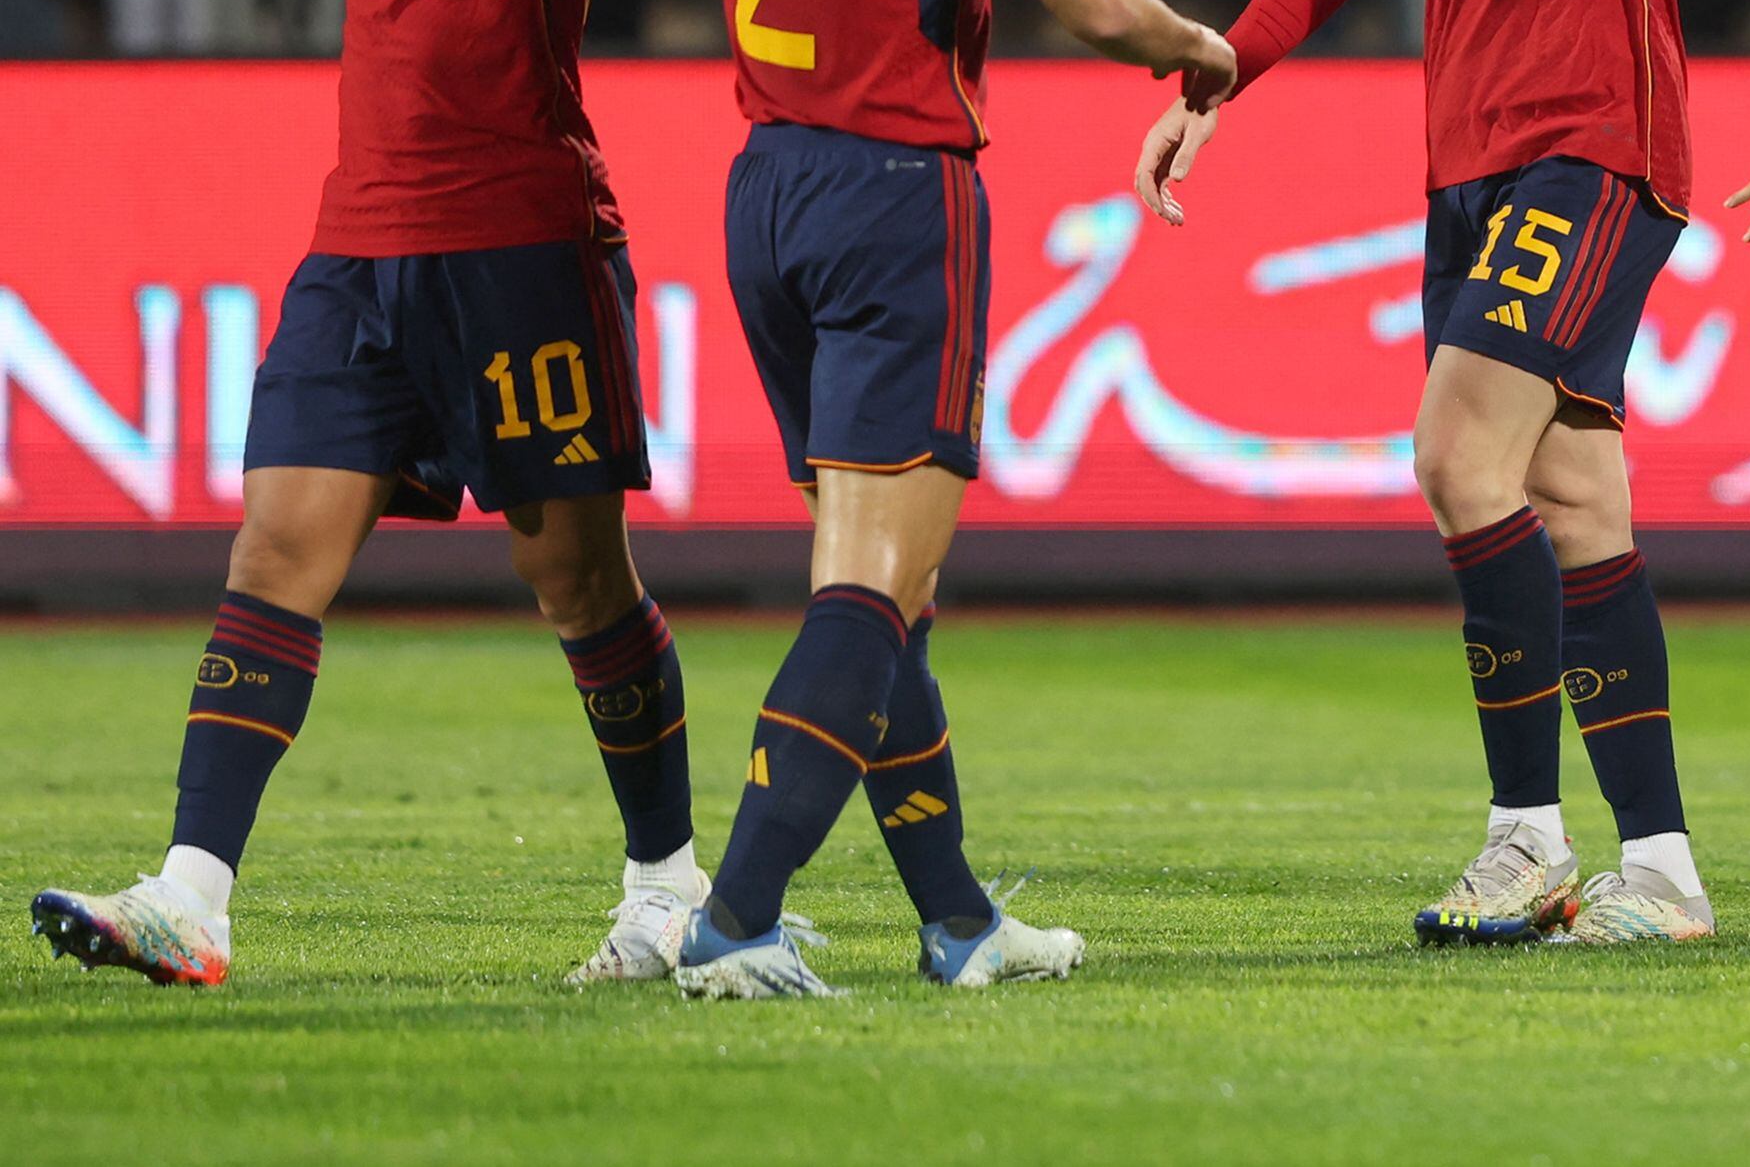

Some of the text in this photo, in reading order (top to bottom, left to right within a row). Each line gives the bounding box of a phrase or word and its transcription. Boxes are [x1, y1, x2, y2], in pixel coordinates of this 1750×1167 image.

[1469, 205, 1573, 297] 15
[484, 340, 592, 439] 10
[1501, 649, 1523, 664] 09
